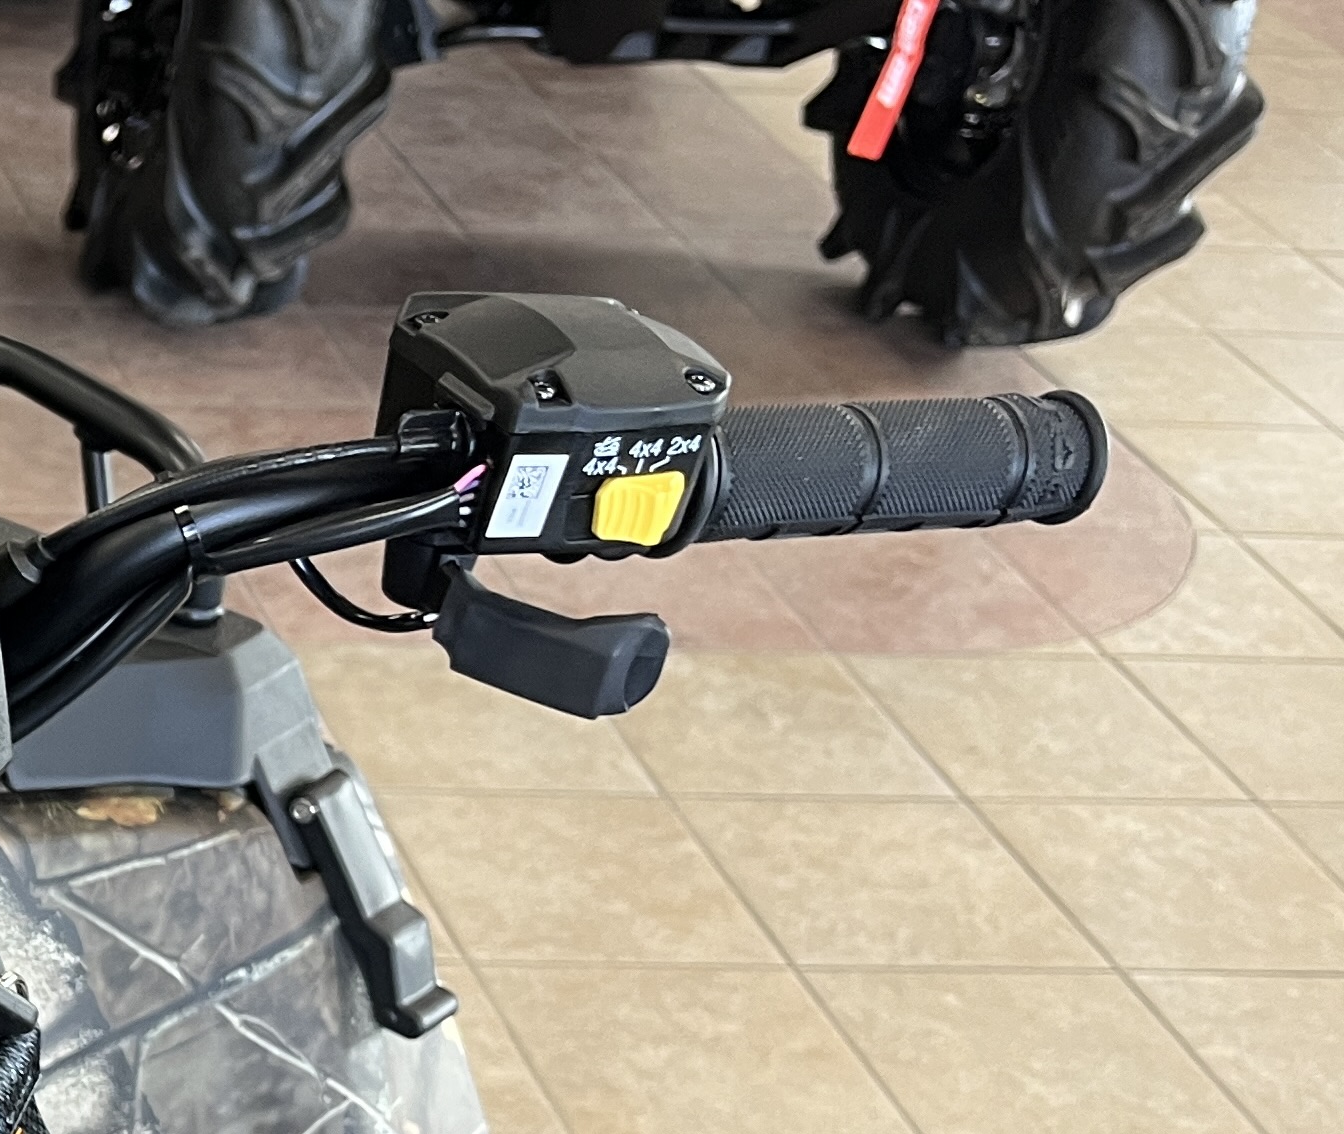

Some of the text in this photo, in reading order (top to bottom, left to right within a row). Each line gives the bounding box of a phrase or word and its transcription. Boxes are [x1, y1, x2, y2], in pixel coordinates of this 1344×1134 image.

[628, 434, 702, 458] 4x4 2x4
[582, 457, 619, 476] 4x4
